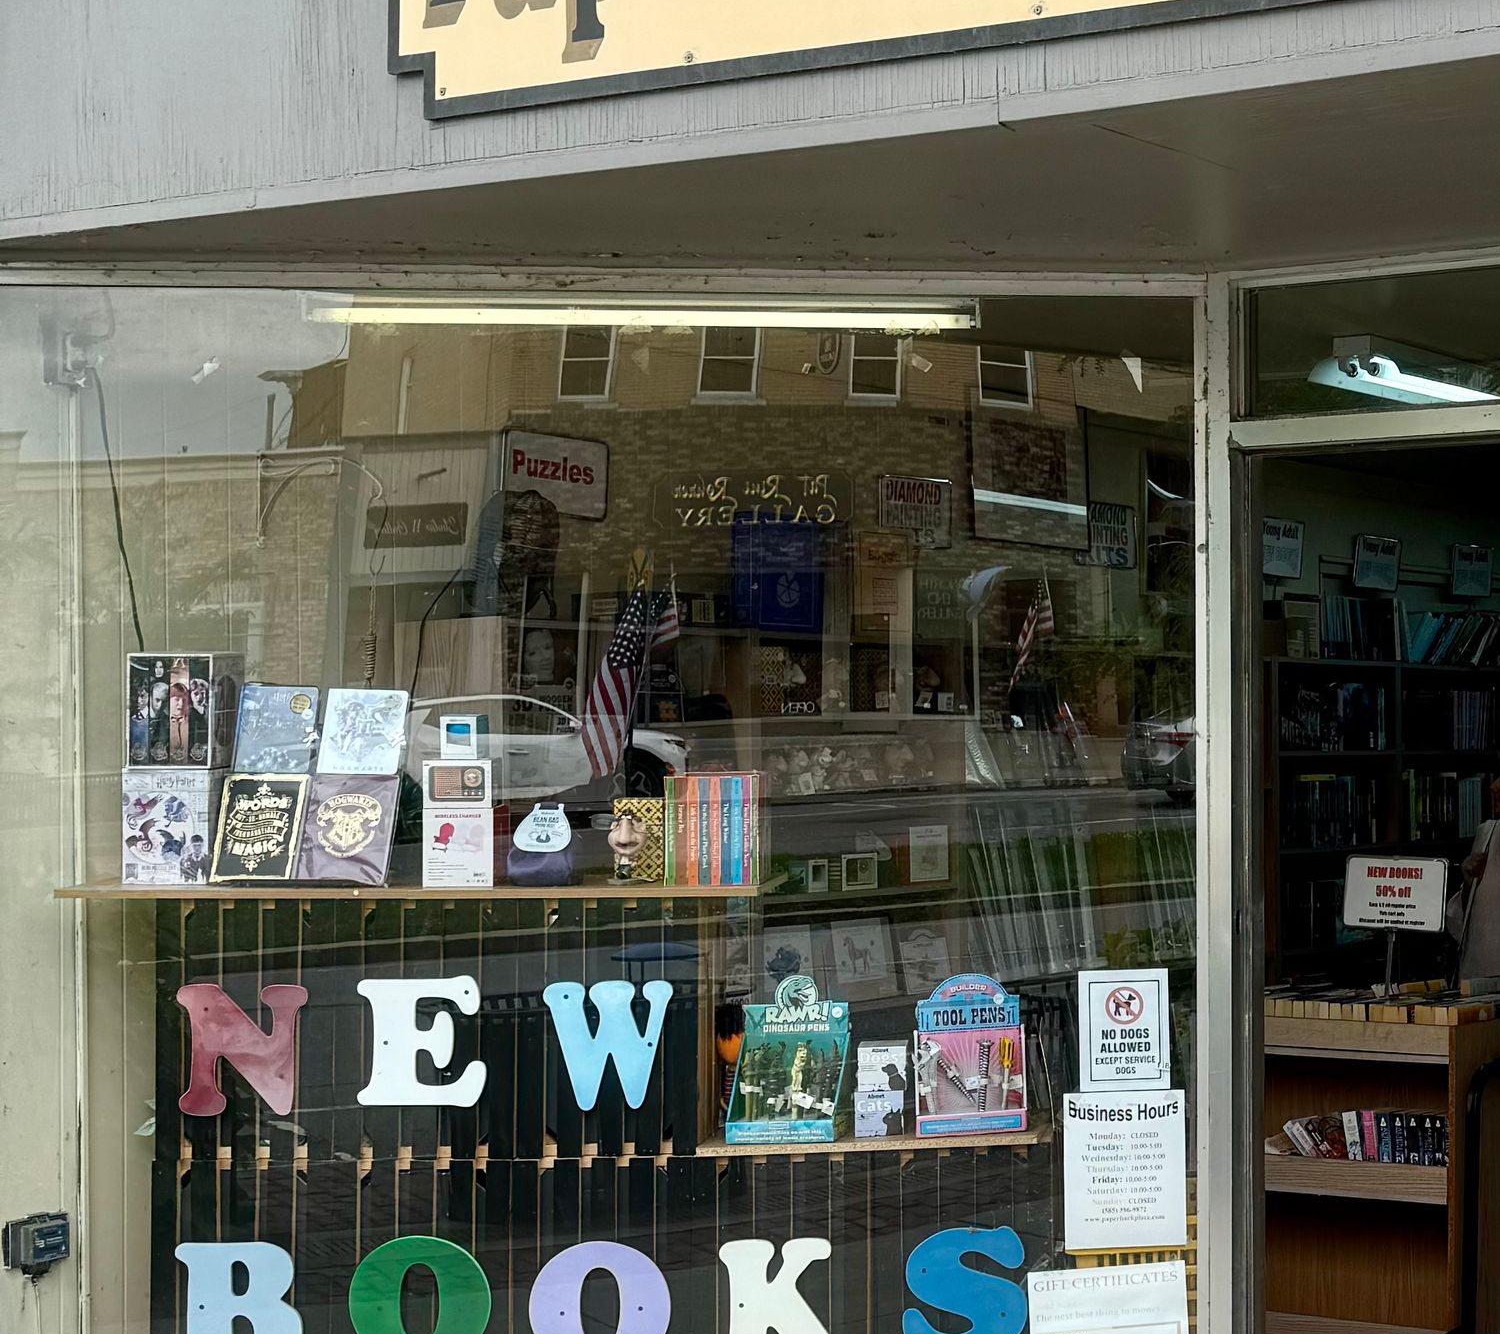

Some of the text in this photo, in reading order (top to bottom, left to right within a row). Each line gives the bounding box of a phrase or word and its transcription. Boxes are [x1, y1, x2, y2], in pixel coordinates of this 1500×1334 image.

[511, 448, 595, 486] Puzzles
[885, 481, 942, 506] DIAMOND
[1087, 502, 1128, 526] AMOND
[1089, 525, 1129, 547] INTING
[238, 796, 288, 811] WORDS
[231, 839, 278, 856] MAGIC
[1367, 866, 1424, 879] NEW BOOKS!
[1375, 885, 1412, 898] 50% off
[764, 1000, 831, 1023] RAWR!
[933, 1006, 1006, 1027] TOOL PENS
[763, 1023, 830, 1033] DINOSAUR PENS
[1101, 1028, 1150, 1040] NO DOGS
[176, 975, 673, 1116] NEW
[1100, 1041, 1151, 1054] ALLOWED
[858, 1051, 899, 1066] Dogs
[1095, 1055, 1156, 1066] EXCEPT SERVICE
[1115, 1066, 1137, 1075] DOGS
[856, 1099, 892, 1113] Cats
[1068, 1099, 1179, 1122] Business Hours
[1088, 1132, 1126, 1141] Monday:
[1086, 1143, 1124, 1152] Tuesday:
[1081, 1154, 1132, 1163] Wednesday:
[1092, 1176, 1123, 1185] Friday:
[1087, 1187, 1128, 1196] Saturday:
[1033, 1270, 1178, 1293] GIFT CERTIFICATES
